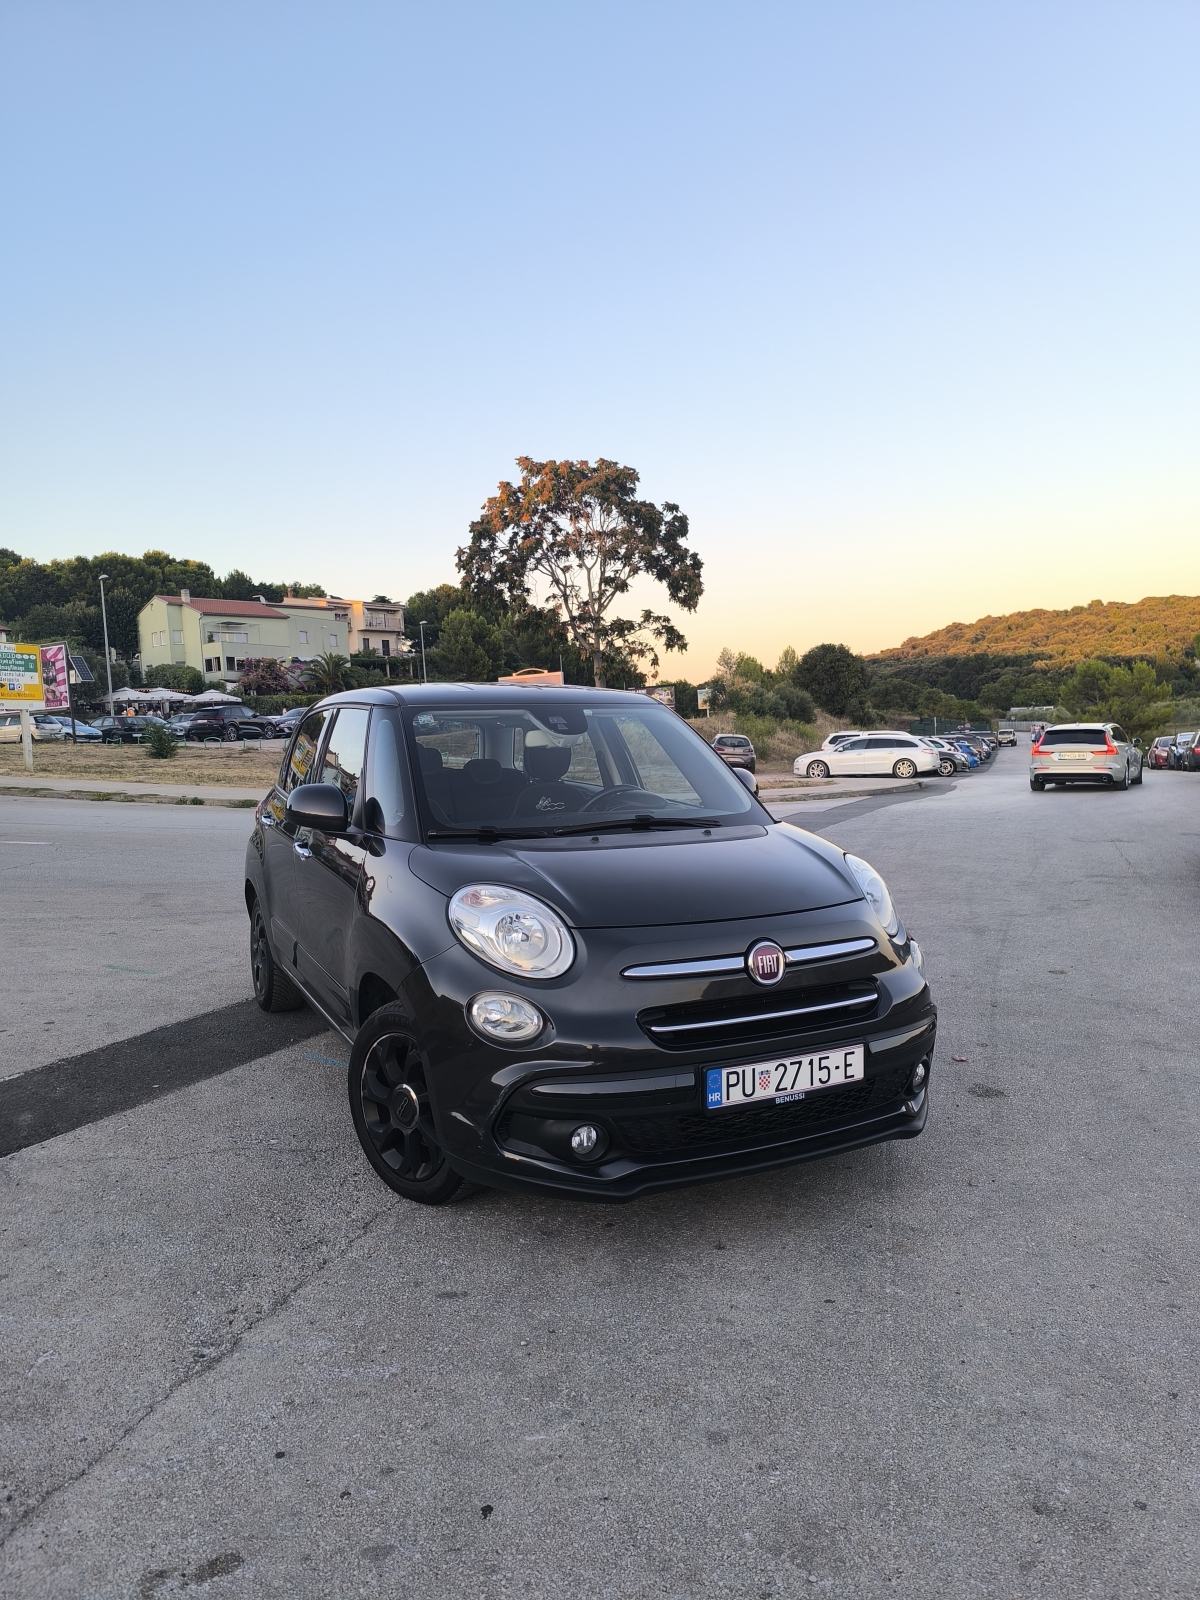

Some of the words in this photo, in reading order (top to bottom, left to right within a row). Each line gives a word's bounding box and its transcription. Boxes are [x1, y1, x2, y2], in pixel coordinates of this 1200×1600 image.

[757, 953, 778, 974] FIAT
[726, 1068, 756, 1101] PU
[774, 1051, 856, 1093] 2715-E
[708, 1092, 721, 1103] HR
[775, 1092, 805, 1105] BENUSSI
